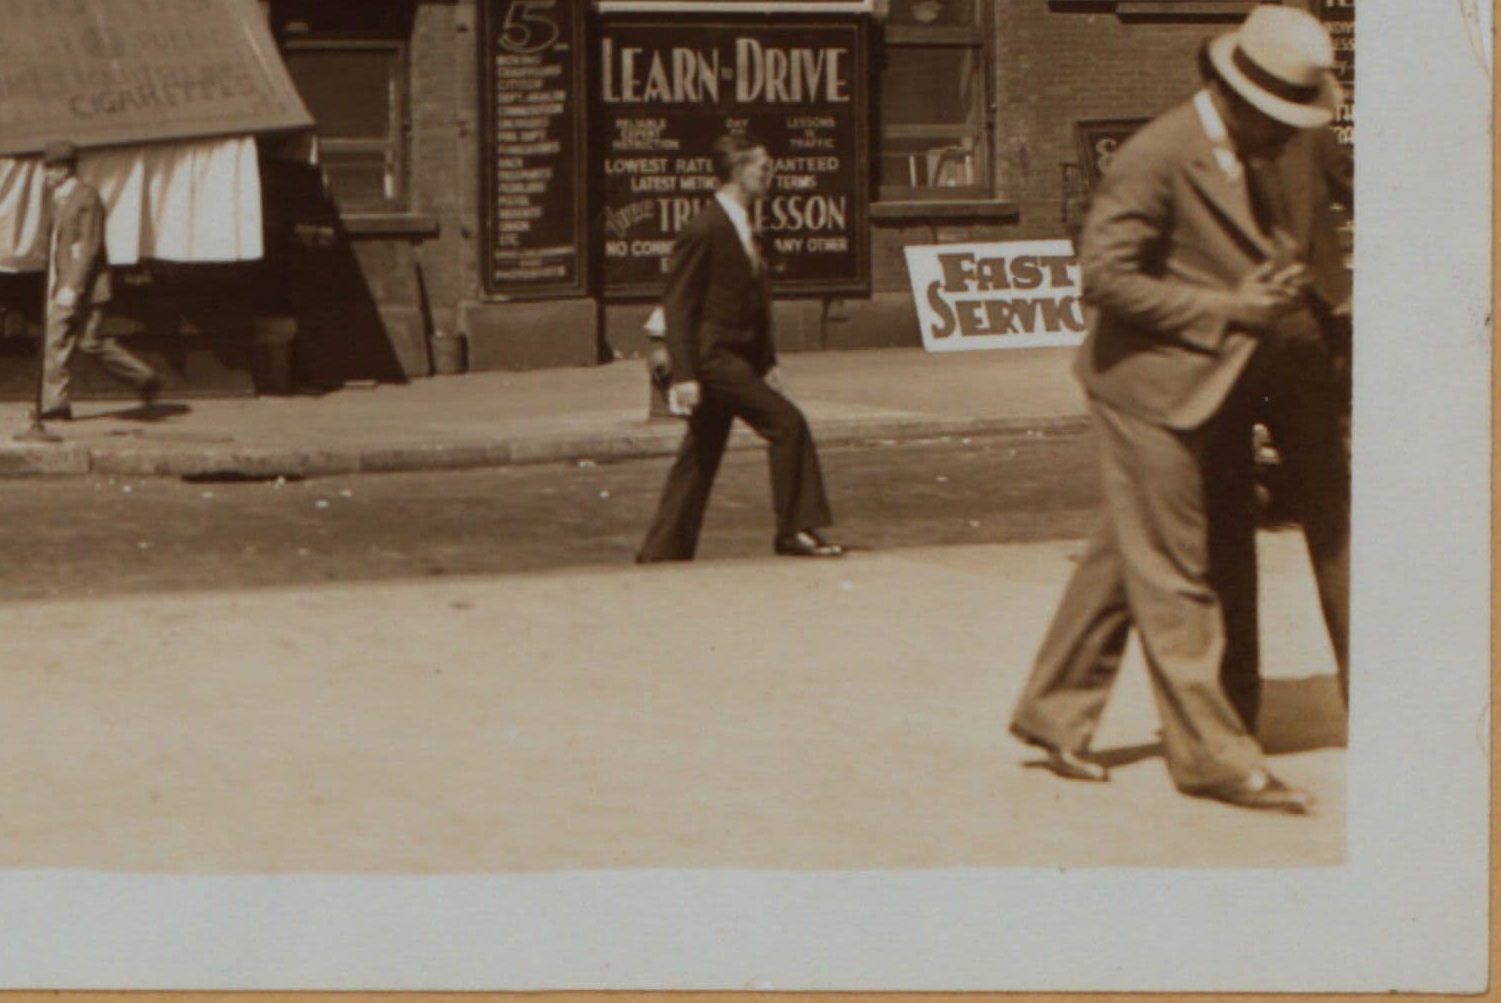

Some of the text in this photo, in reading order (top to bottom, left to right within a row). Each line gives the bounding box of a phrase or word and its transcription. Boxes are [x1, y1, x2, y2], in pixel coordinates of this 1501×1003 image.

[602, 38, 850, 103] LEARN DRIVE
[605, 158, 668, 174] LOWEST
[676, 159, 714, 173] RATE
[753, 196, 846, 231] ESSON
[937, 252, 1077, 294] FAST
[926, 280, 1087, 339] SERVIC
